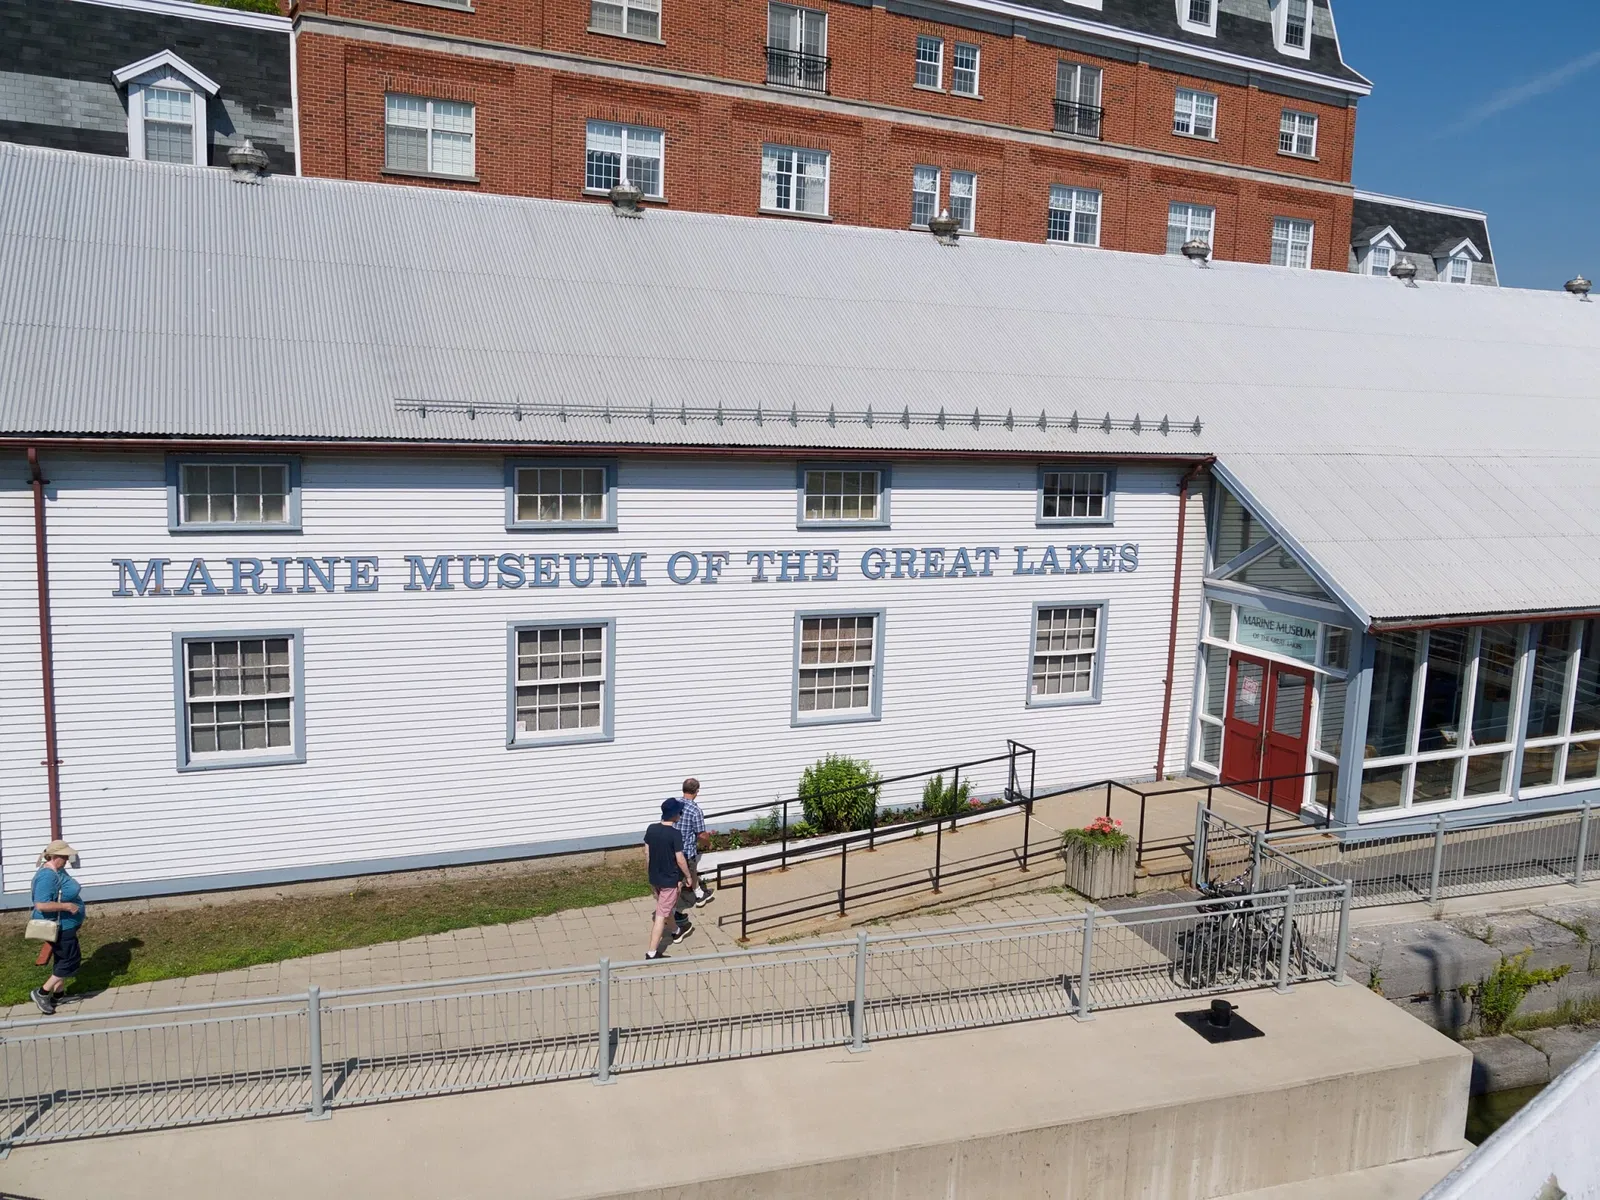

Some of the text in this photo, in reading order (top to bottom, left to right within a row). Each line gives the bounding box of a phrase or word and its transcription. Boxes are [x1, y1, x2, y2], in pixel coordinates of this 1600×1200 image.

[111, 543, 1139, 597] MARINE MUSEUM OF THE GREAT LAKES
[1243, 615, 1316, 639] MARINE MUSEUM
